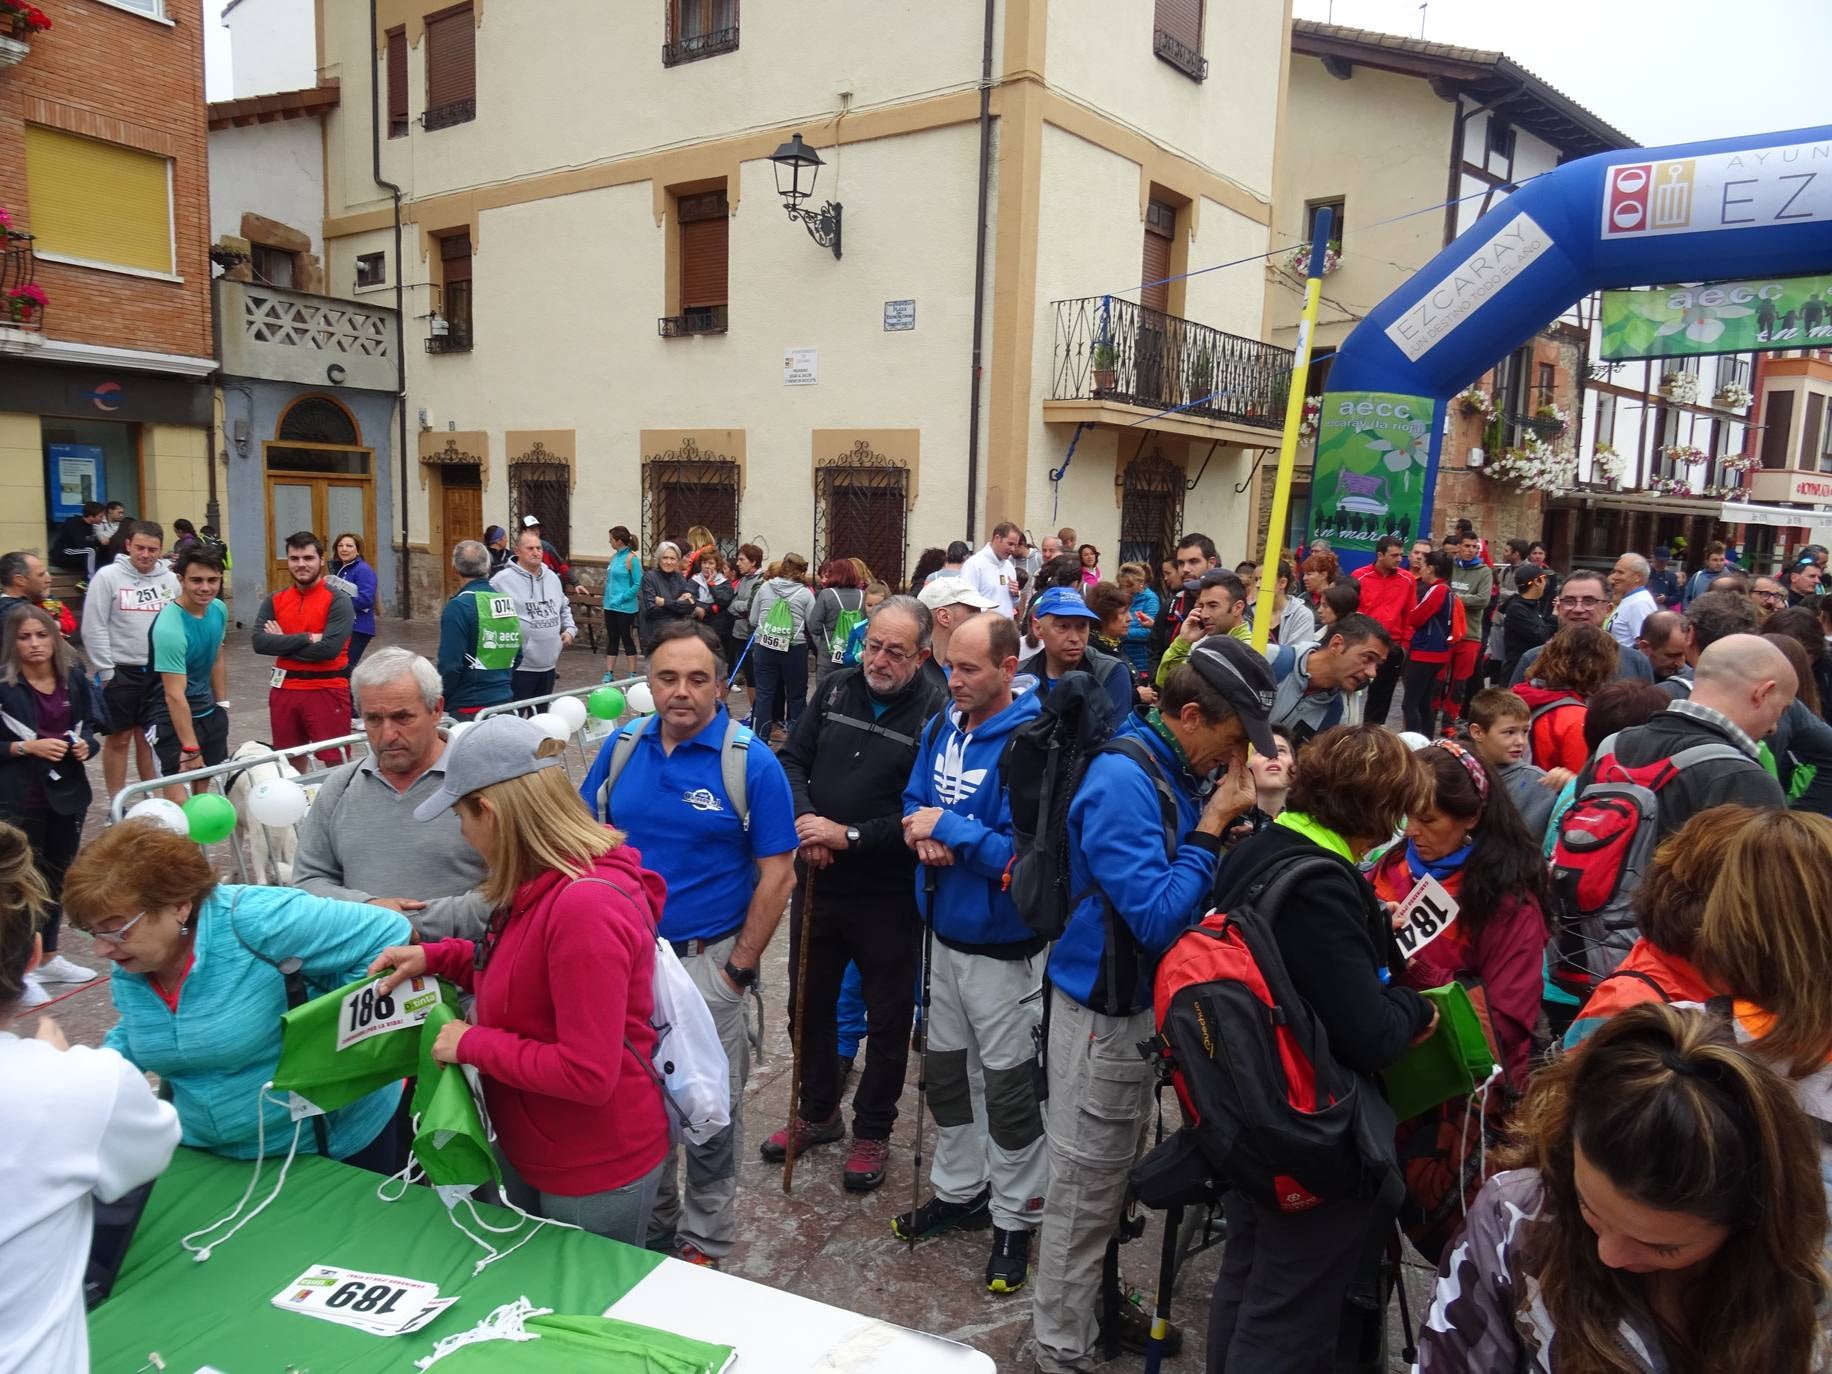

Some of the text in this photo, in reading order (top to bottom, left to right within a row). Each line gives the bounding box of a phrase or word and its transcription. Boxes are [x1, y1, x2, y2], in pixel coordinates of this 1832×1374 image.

[1721, 173, 1817, 224] EZ
[1396, 222, 1526, 341] EZCARAY
[1428, 301, 1471, 337] DESTINO
[1471, 275, 1501, 301] TODO
[1501, 261, 1518, 277] EL
[1517, 240, 1541, 264] AÑO
[1667, 284, 1784, 310] aecc
[1338, 400, 1411, 419] aecc
[1313, 528, 1336, 537] en
[136, 587, 159, 603] 251
[763, 635, 779, 647] 056
[1394, 894, 1449, 952] 184
[325, 1282, 407, 1315] 189
